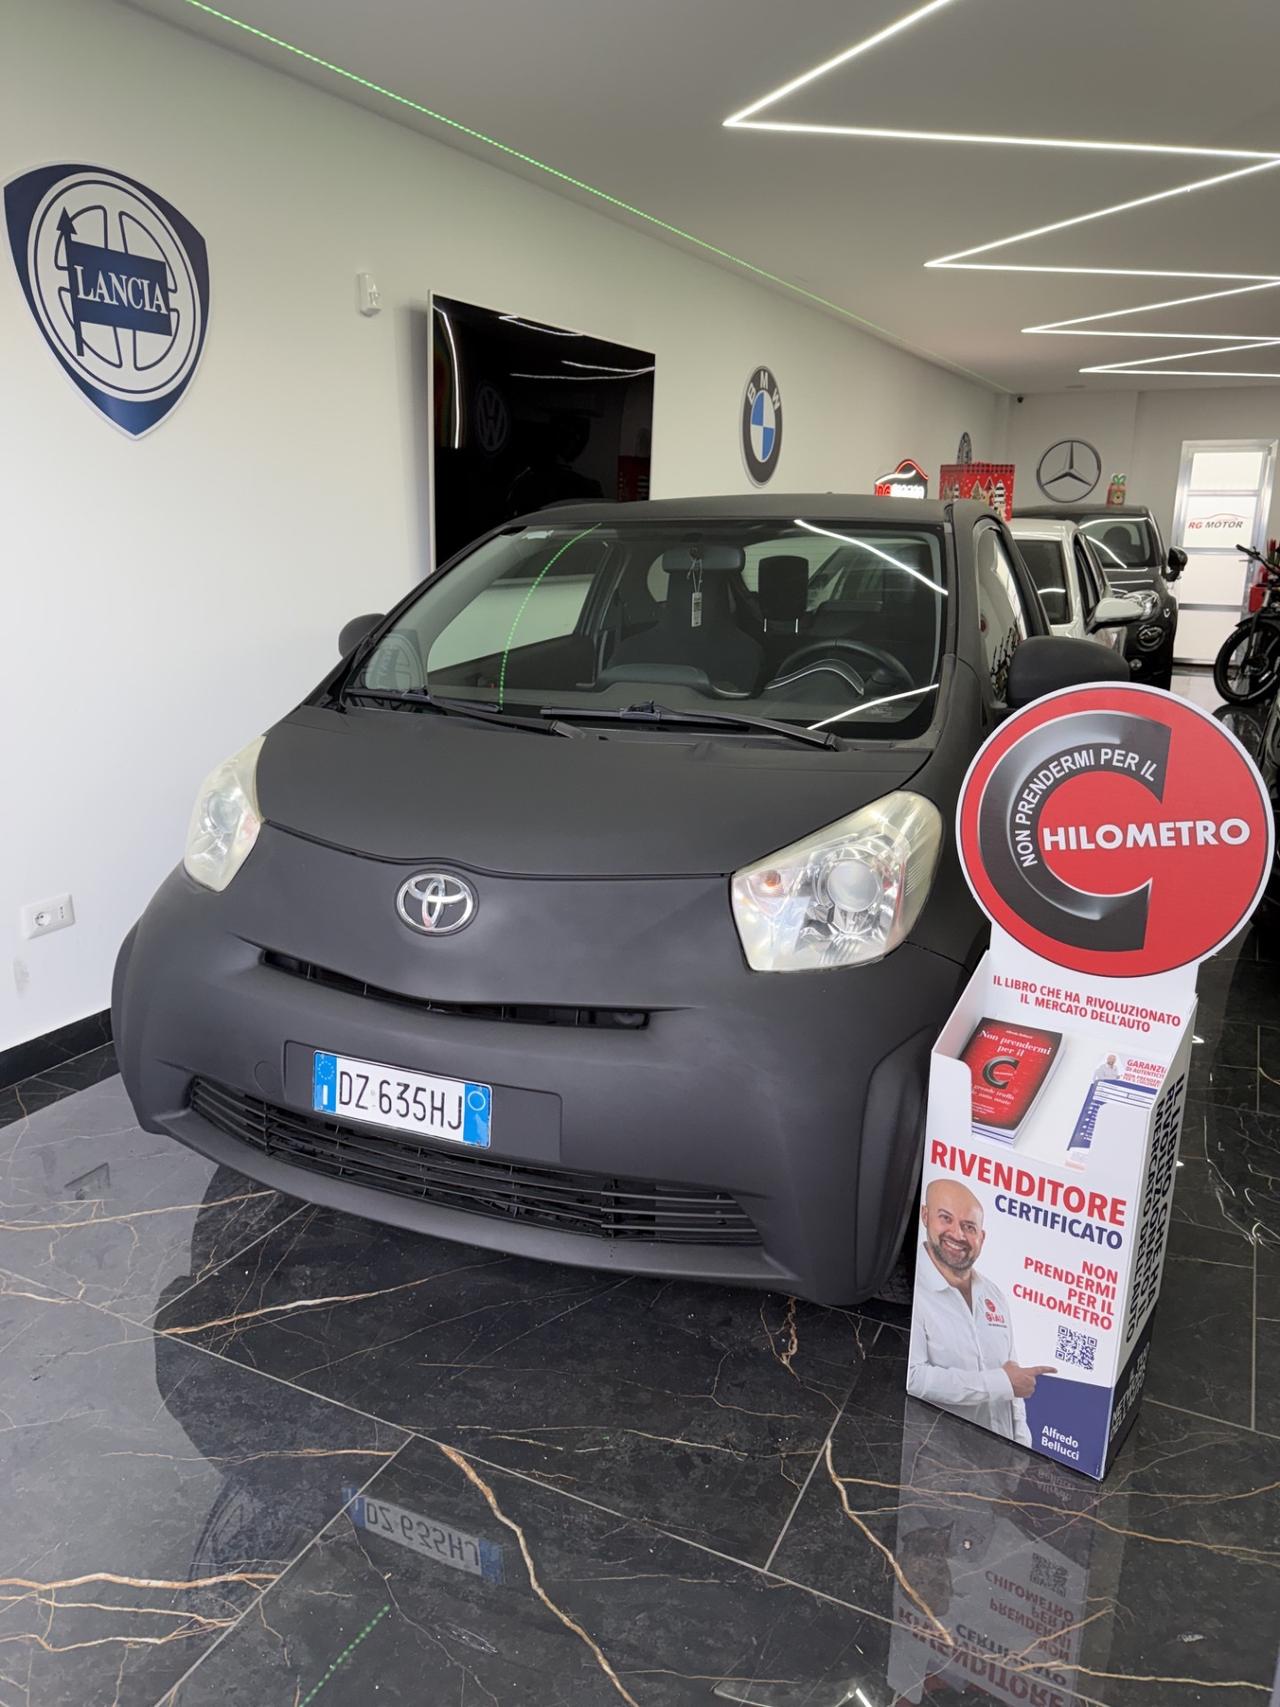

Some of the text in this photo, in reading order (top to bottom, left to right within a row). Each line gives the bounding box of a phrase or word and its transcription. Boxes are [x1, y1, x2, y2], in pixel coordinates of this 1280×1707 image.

[74, 265, 168, 315] LANCIA
[747, 370, 780, 410] BMW
[1188, 520, 1244, 530] RG MOTOR
[1015, 748, 1158, 867] NON PRENDERMI PER IL
[993, 975, 1182, 1028] IL LIBRO CHE HA RIVOLUZIONATO
[1020, 993, 1151, 1033] IL MERCATO DELL'AUTO
[980, 1030, 999, 1041] Non
[1000, 1037, 1053, 1056] prendermi
[997, 1045, 1025, 1057] per il
[339, 1071, 463, 1130] DZ 635HJ
[1143, 1097, 1165, 1217] MERCATO
[931, 1139, 1127, 1227] RIVENDITORE
[1146, 1073, 1185, 1310] IL LIBRO CHE HA
[994, 1194, 1123, 1250] CERTIFICATO
[1024, 1256, 1117, 1300] PRENDERMI
[1082, 1260, 1118, 1284] NON
[1126, 1220, 1149, 1343] DELL'AUTO
[1012, 1283, 1113, 1330] CHILOMETRO
[1067, 1287, 1115, 1316] PER IL
[1136, 1298, 1147, 1328] IL
[1041, 1436, 1080, 1460] Bellucci
[1042, 1425, 1079, 1448] Alfredo
